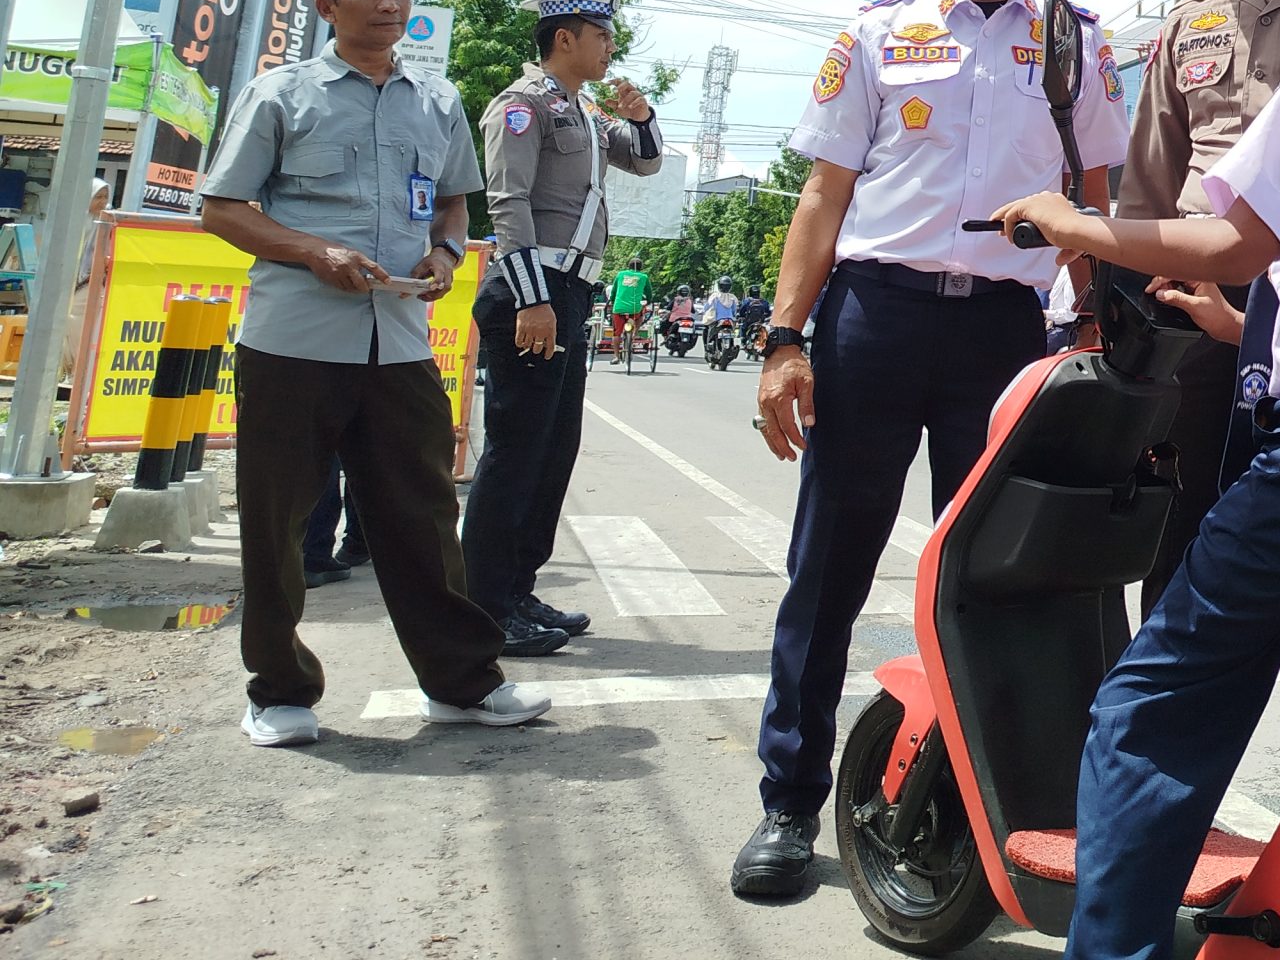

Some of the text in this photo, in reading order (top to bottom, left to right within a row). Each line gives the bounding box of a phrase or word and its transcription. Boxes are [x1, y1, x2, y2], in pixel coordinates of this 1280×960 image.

[893, 47, 949, 61] BUDI
[1015, 49, 1043, 63] DIS
[157, 167, 194, 185] HOTLINE
